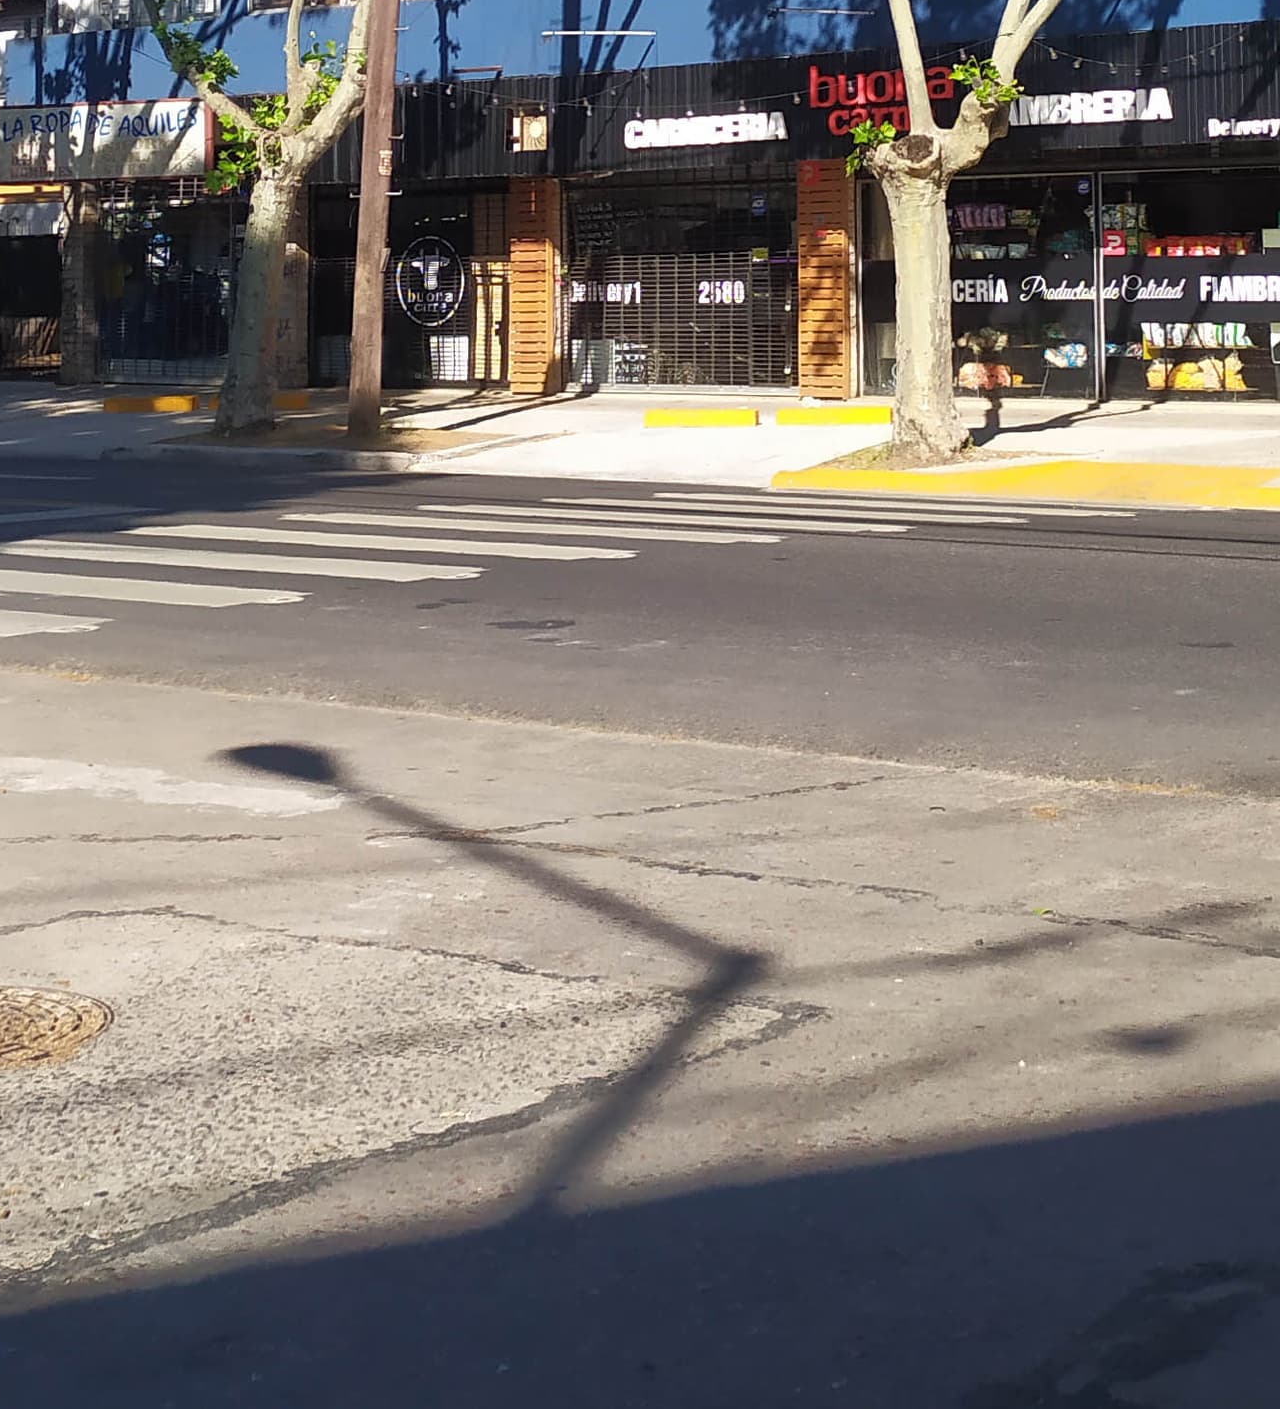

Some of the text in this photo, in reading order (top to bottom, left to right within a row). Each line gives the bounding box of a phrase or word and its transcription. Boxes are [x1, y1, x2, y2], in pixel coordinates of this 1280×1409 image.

[2, 107, 197, 142] LA ROPA DE AQUILES
[1208, 117, 1280, 138] Delivery
[952, 274, 1009, 303] CERÍA
[1103, 280, 1120, 300] de
[1122, 274, 1186, 303] Calidad
